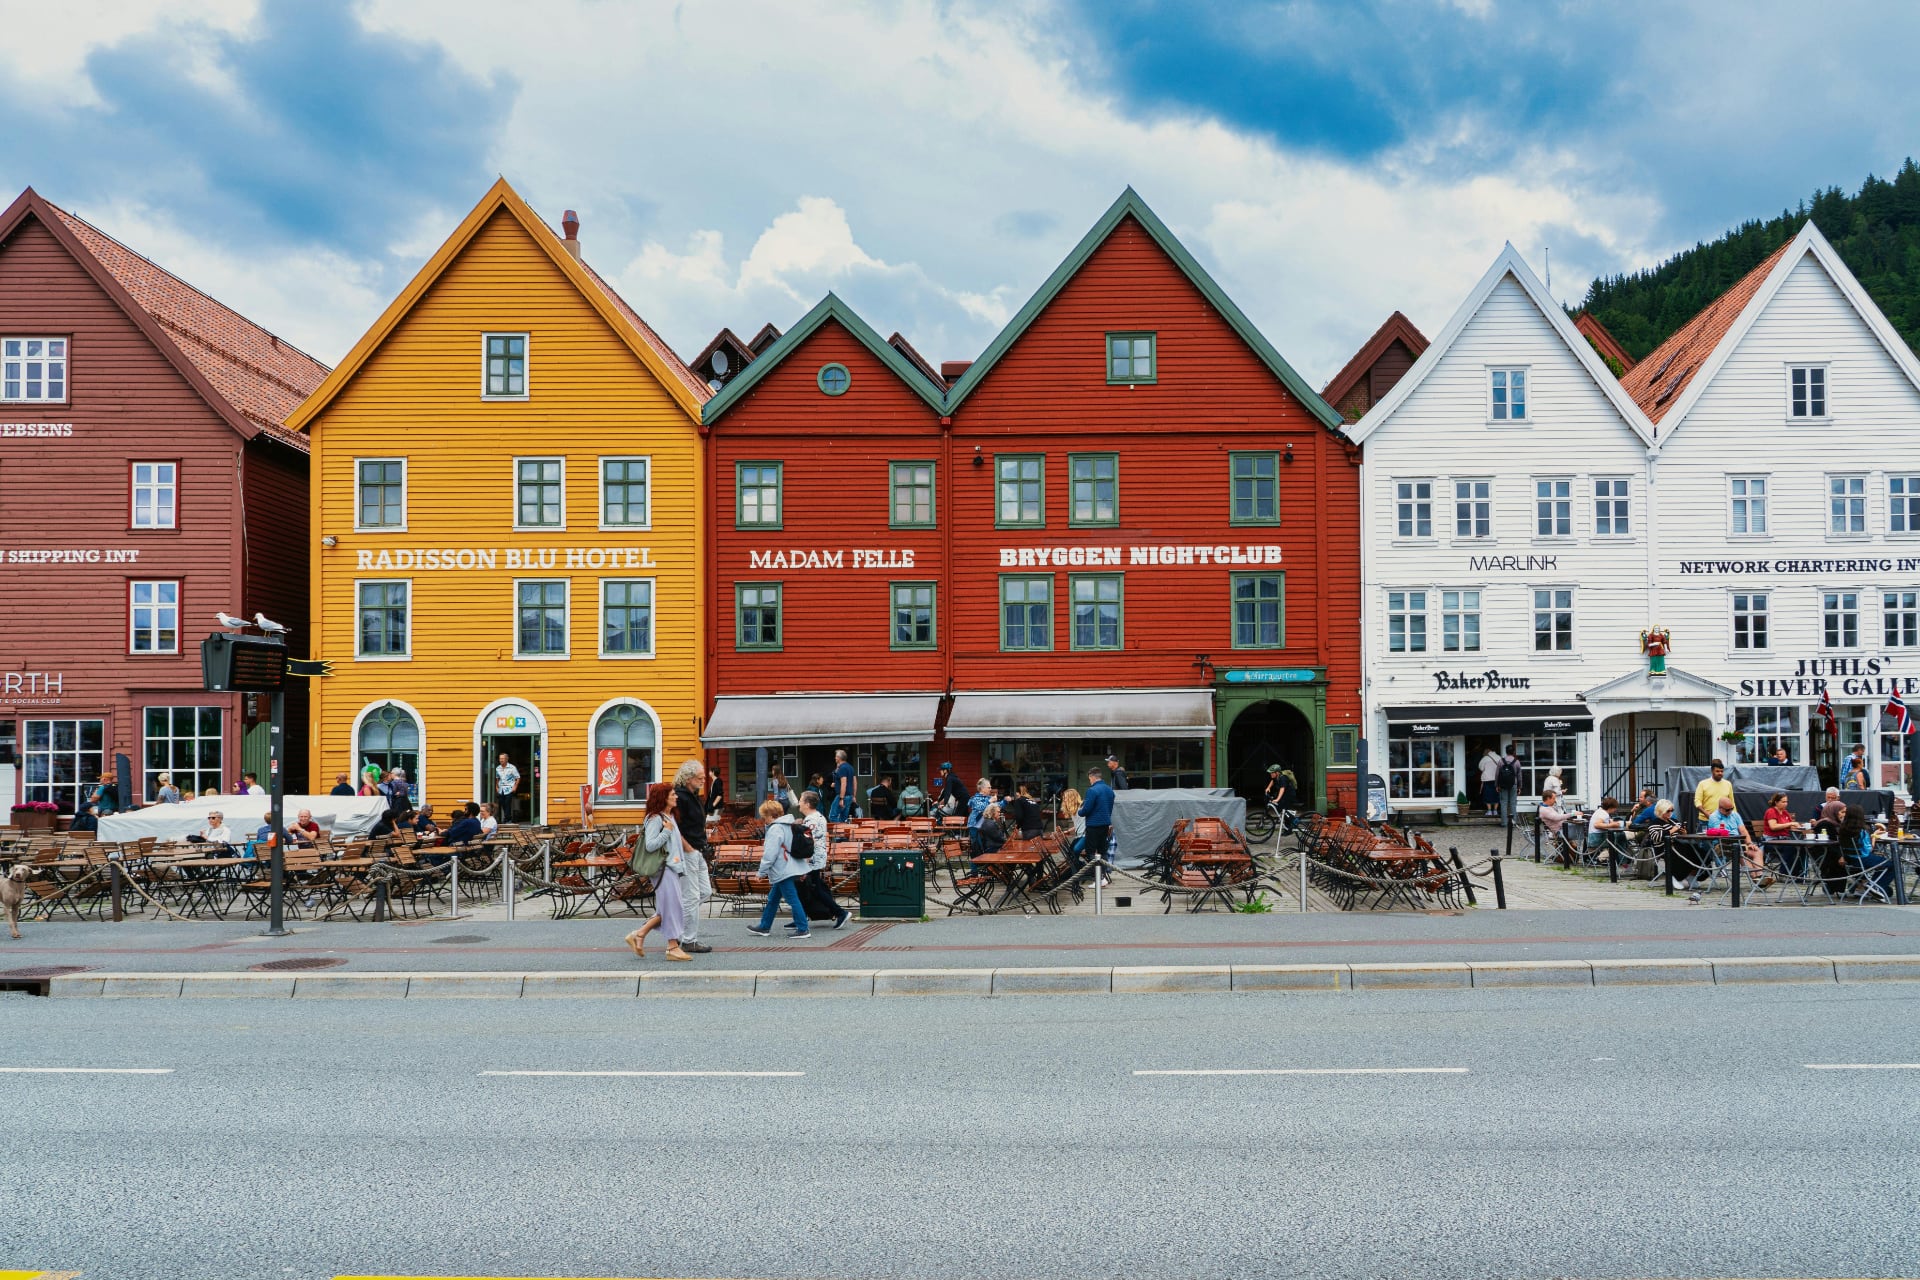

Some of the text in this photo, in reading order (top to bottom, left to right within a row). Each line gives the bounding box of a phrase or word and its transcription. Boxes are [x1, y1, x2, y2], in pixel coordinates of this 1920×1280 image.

[0, 424, 73, 437] EBSENS
[8, 549, 101, 563] SHIPPING
[105, 549, 140, 563] INT
[356, 547, 657, 571] RADISSON BLU HOTEL
[749, 549, 915, 569] MADAM FELLE
[999, 545, 1282, 567] BRYGGEN NIGHTCLUB
[1469, 555, 1558, 571] MARLINK
[1680, 558, 1920, 574] NETWORK CHARTERING IN
[0, 672, 63, 695] RTH
[1740, 678, 1828, 697] SILVER
